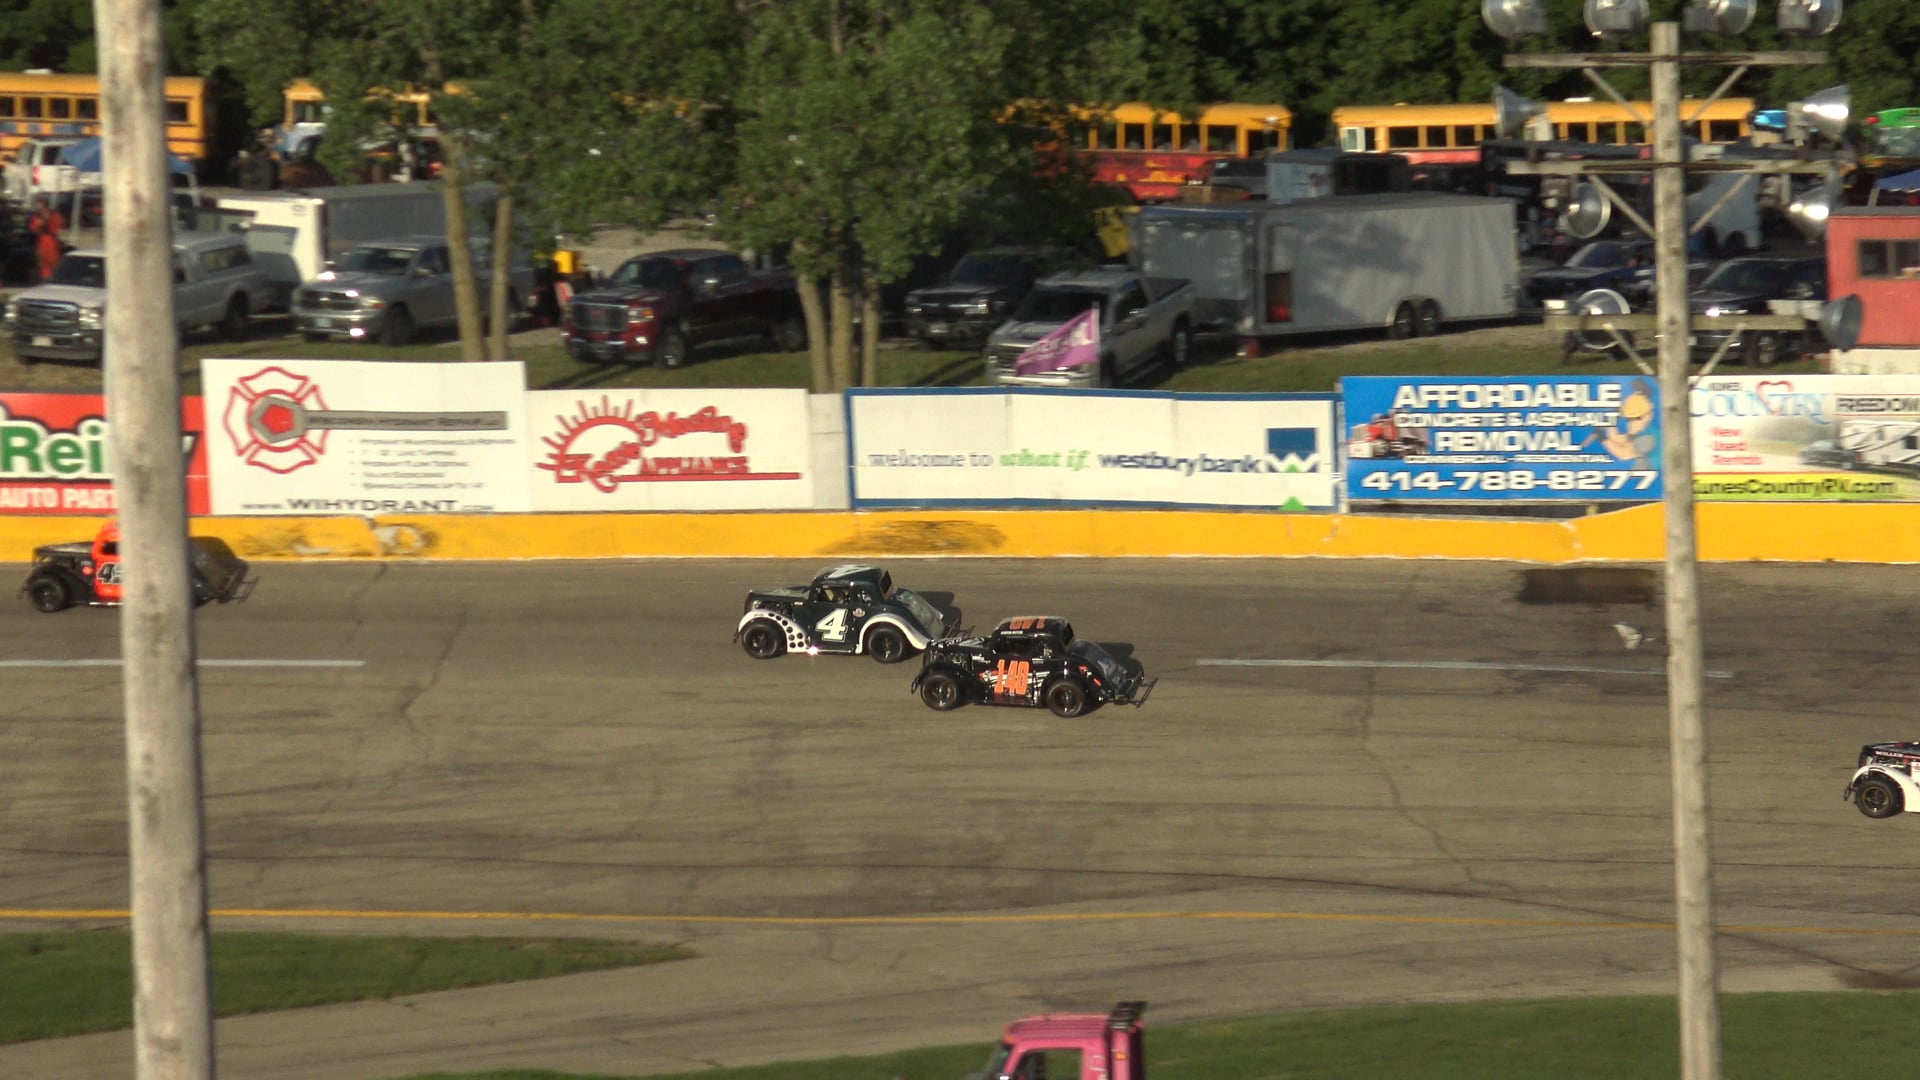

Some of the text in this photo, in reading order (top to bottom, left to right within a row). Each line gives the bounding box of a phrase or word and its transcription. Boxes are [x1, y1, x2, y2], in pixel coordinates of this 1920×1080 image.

[1394, 384, 1622, 408] AFFORDABLE
[1394, 412, 1506, 427] CONCRETE
[1525, 413, 1619, 427] ASPHALT
[1434, 431, 1583, 452] REMOVAL
[867, 449, 965, 467] welcome
[969, 452, 994, 467] to
[1361, 470, 1659, 491] 414-788-8277
[0, 487, 118, 508] AUTO PART
[815, 608, 849, 641] 4
